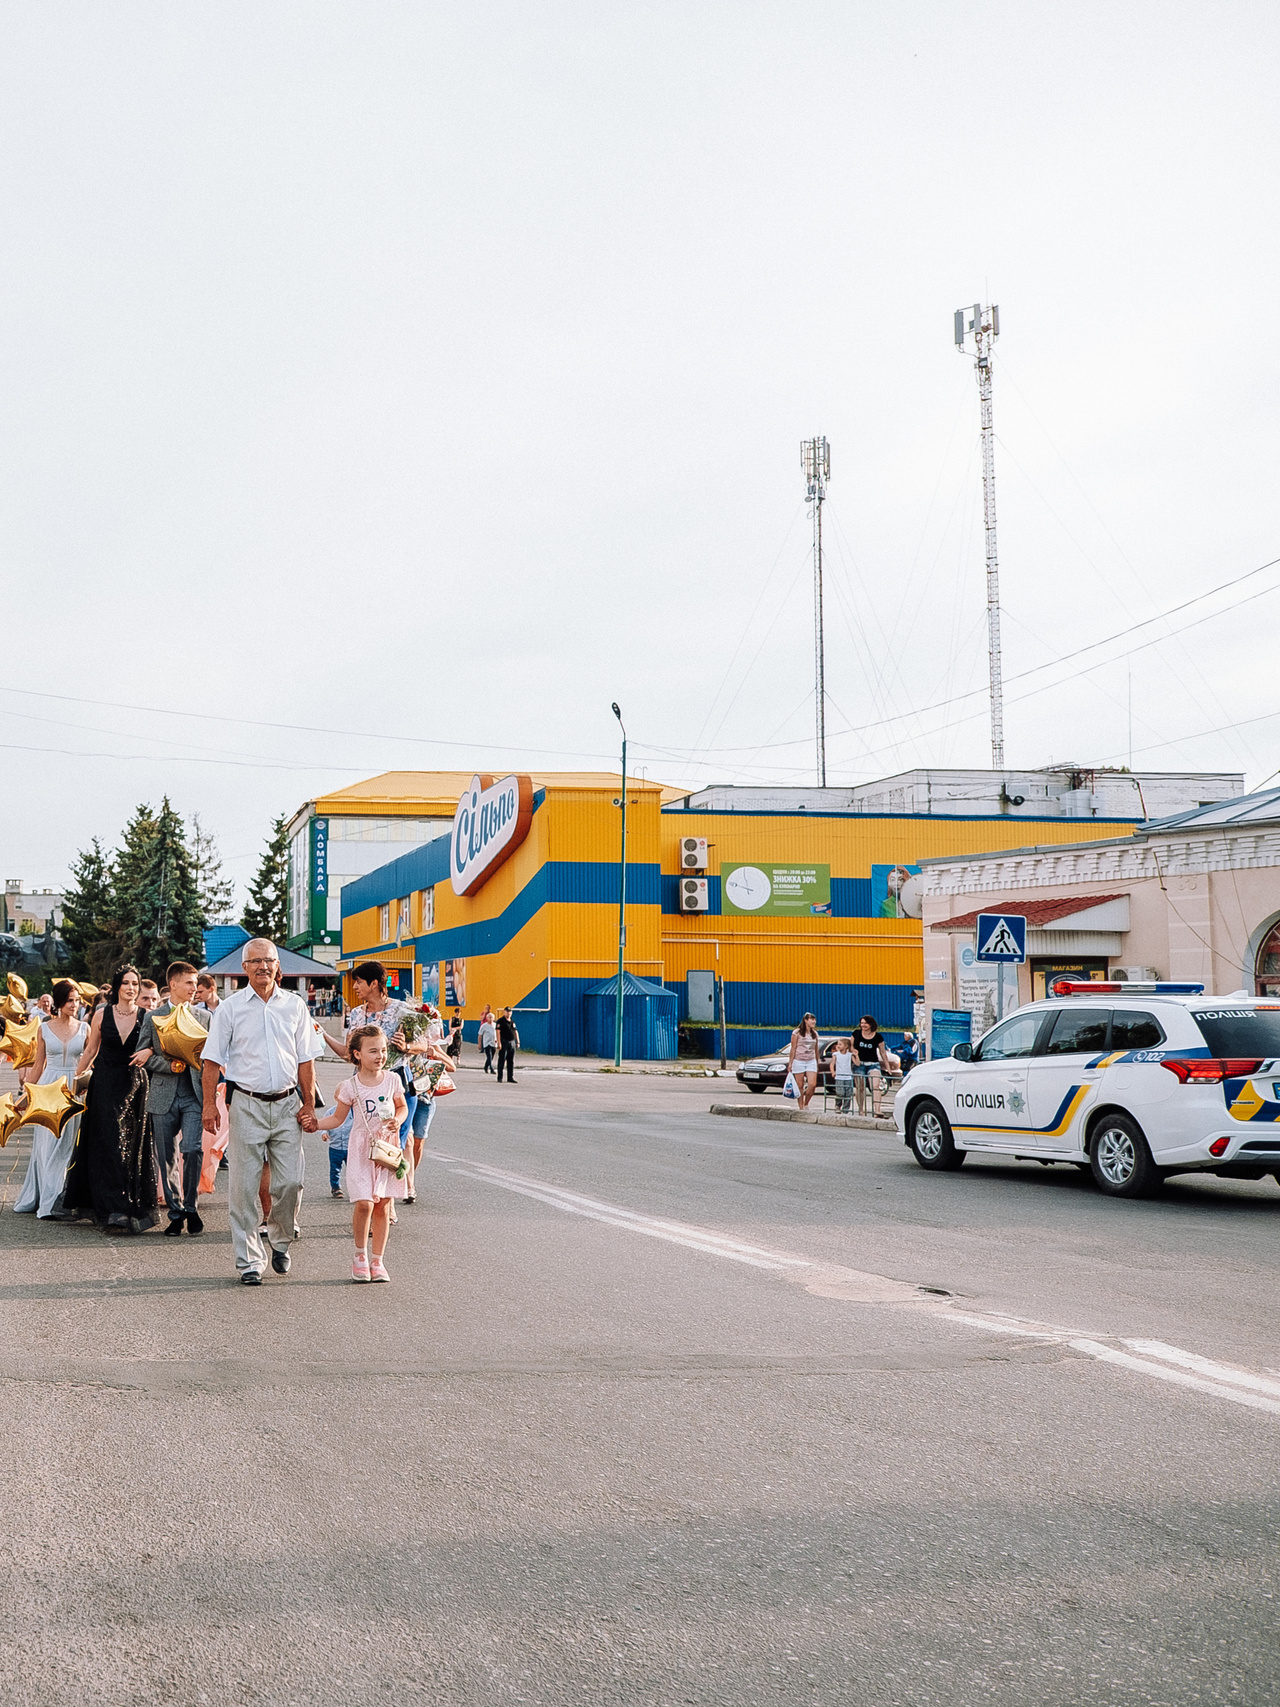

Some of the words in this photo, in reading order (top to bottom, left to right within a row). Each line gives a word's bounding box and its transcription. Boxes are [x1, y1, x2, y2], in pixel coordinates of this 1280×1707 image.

[456, 788, 515, 874] Сільпо
[772, 875, 802, 884] ЗНИЖКА
[801, 876, 817, 884] 30%
[1195, 1011, 1257, 1021] ПОЛІЦІЯ
[1145, 1052, 1166, 1061] 102
[956, 1093, 1005, 1109] ПОЛІЦІЯ
